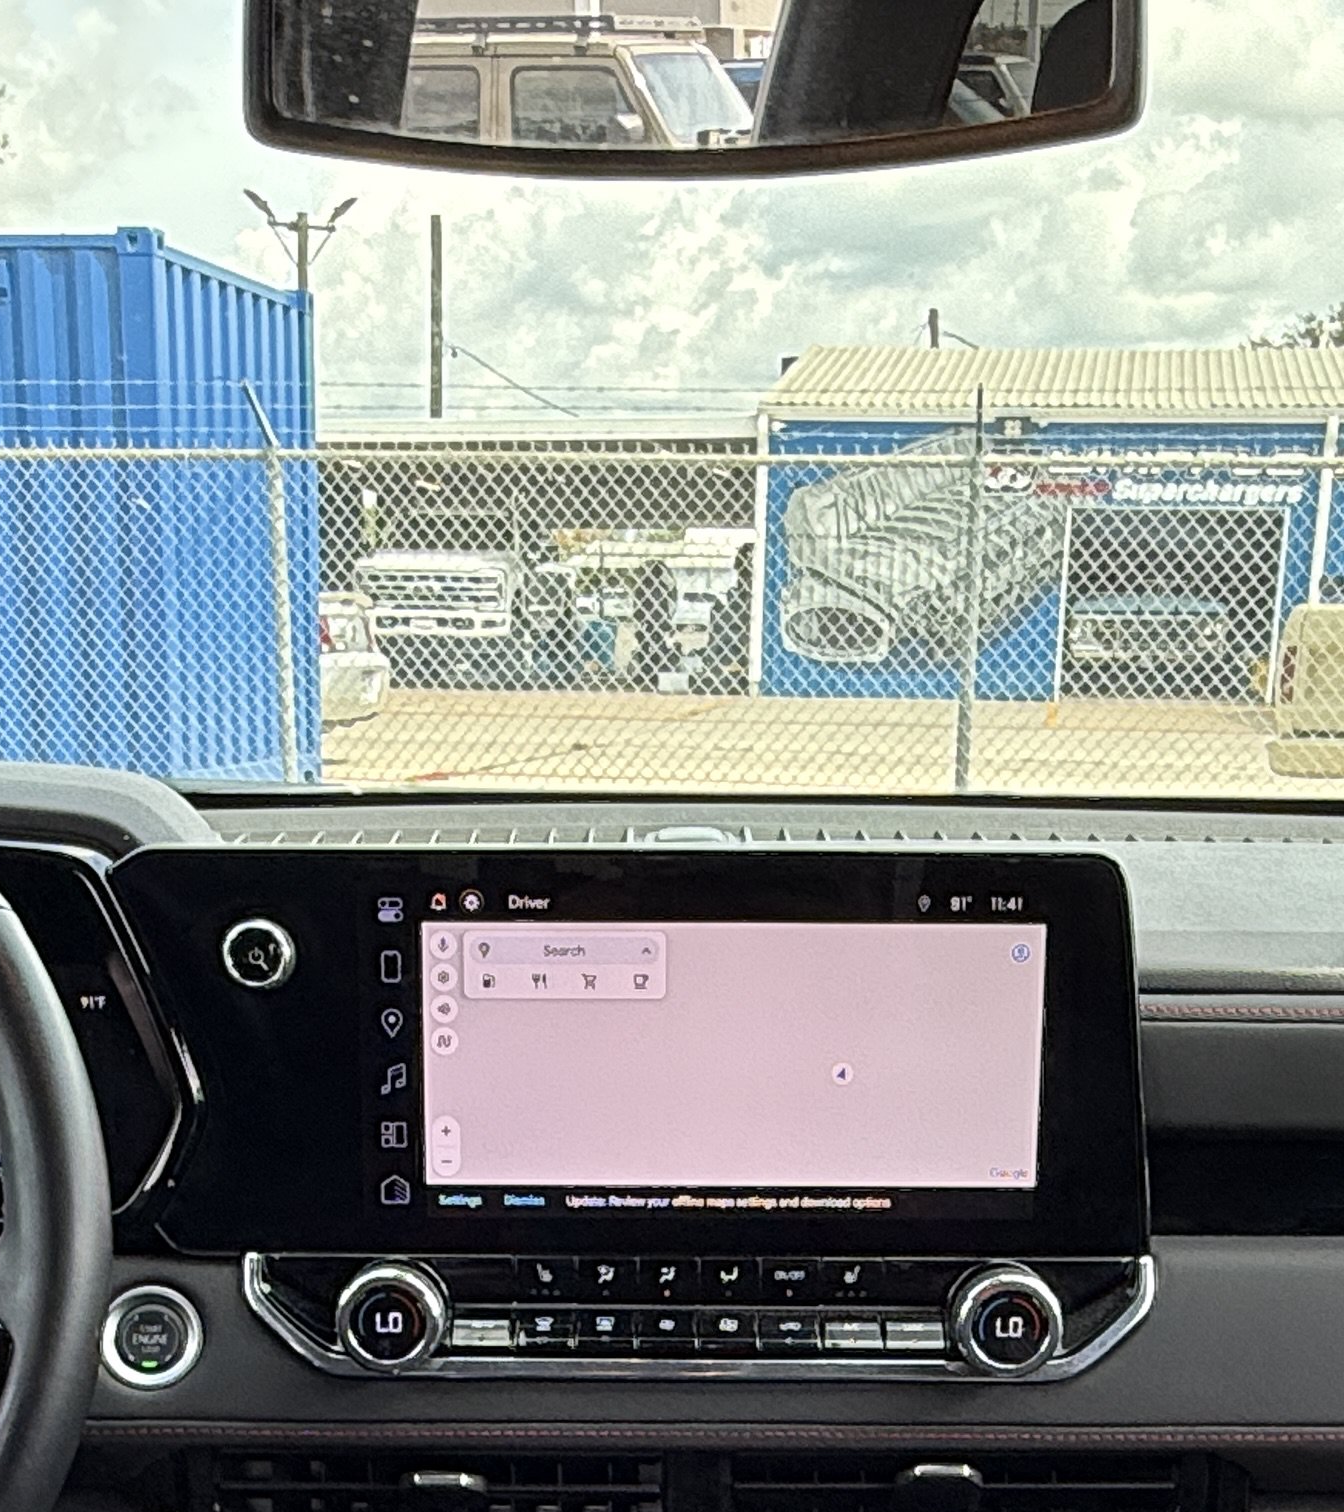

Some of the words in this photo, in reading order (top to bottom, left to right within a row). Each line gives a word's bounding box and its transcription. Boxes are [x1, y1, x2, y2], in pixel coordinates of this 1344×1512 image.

[508, 894, 551, 910] Driver
[991, 896, 1024, 912] 11:41
[543, 944, 586, 958] Search
[989, 1167, 1029, 1180] Google
[375, 1311, 403, 1333] LO
[995, 1316, 1024, 1338] LO
